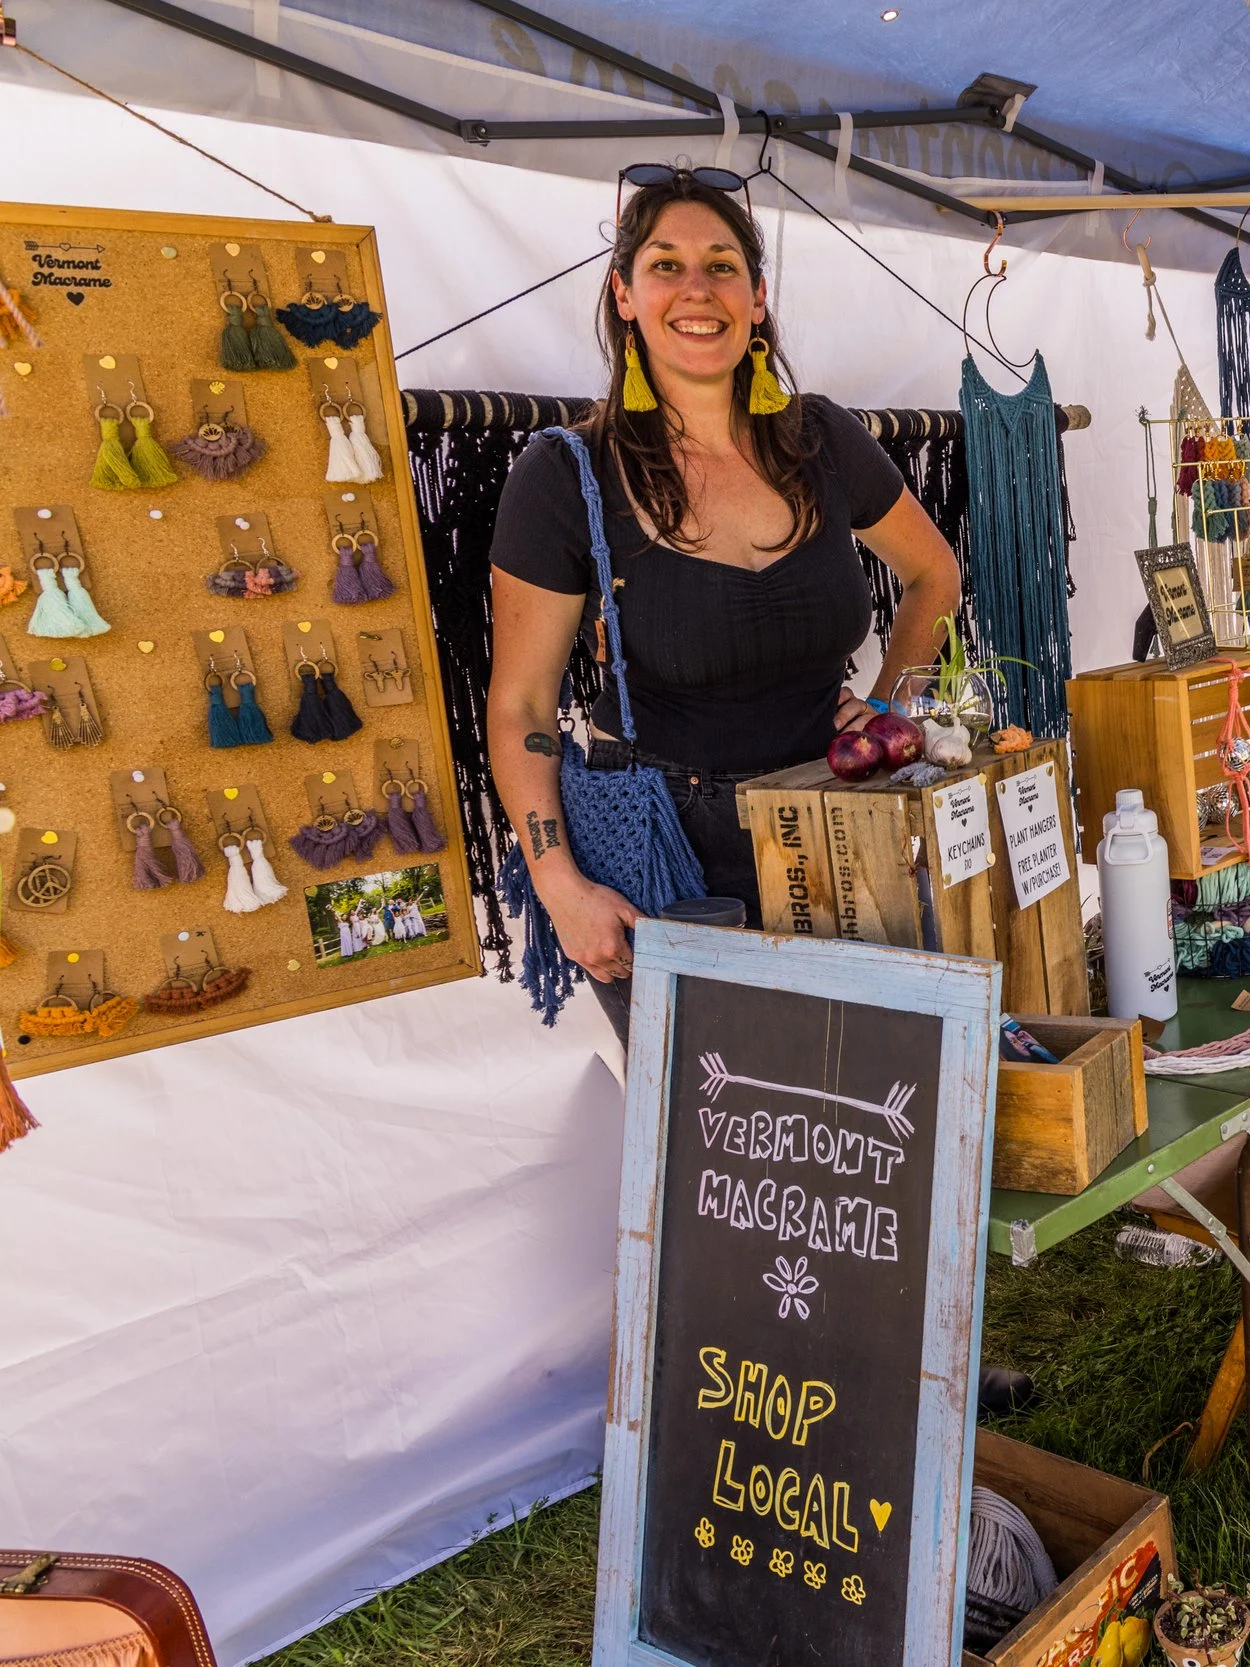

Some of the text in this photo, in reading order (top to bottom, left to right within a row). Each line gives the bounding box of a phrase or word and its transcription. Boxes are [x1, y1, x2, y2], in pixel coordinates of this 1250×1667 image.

[32, 254, 102, 270] Vermont
[32, 272, 112, 287] Macrame
[950, 795, 971, 808] Vermont
[951, 805, 975, 820] Macrame
[778, 805, 803, 848] INC
[1009, 815, 1057, 849] PLANT HANGERS
[948, 833, 985, 861] KEYCHAINS
[1017, 843, 1057, 876] FREE PLANTER
[698, 1108, 905, 1184] VERMONT
[698, 1169, 898, 1261] MACRAME
[698, 1347, 836, 1446] SHOP
[713, 1439, 859, 1553] LOCAL
